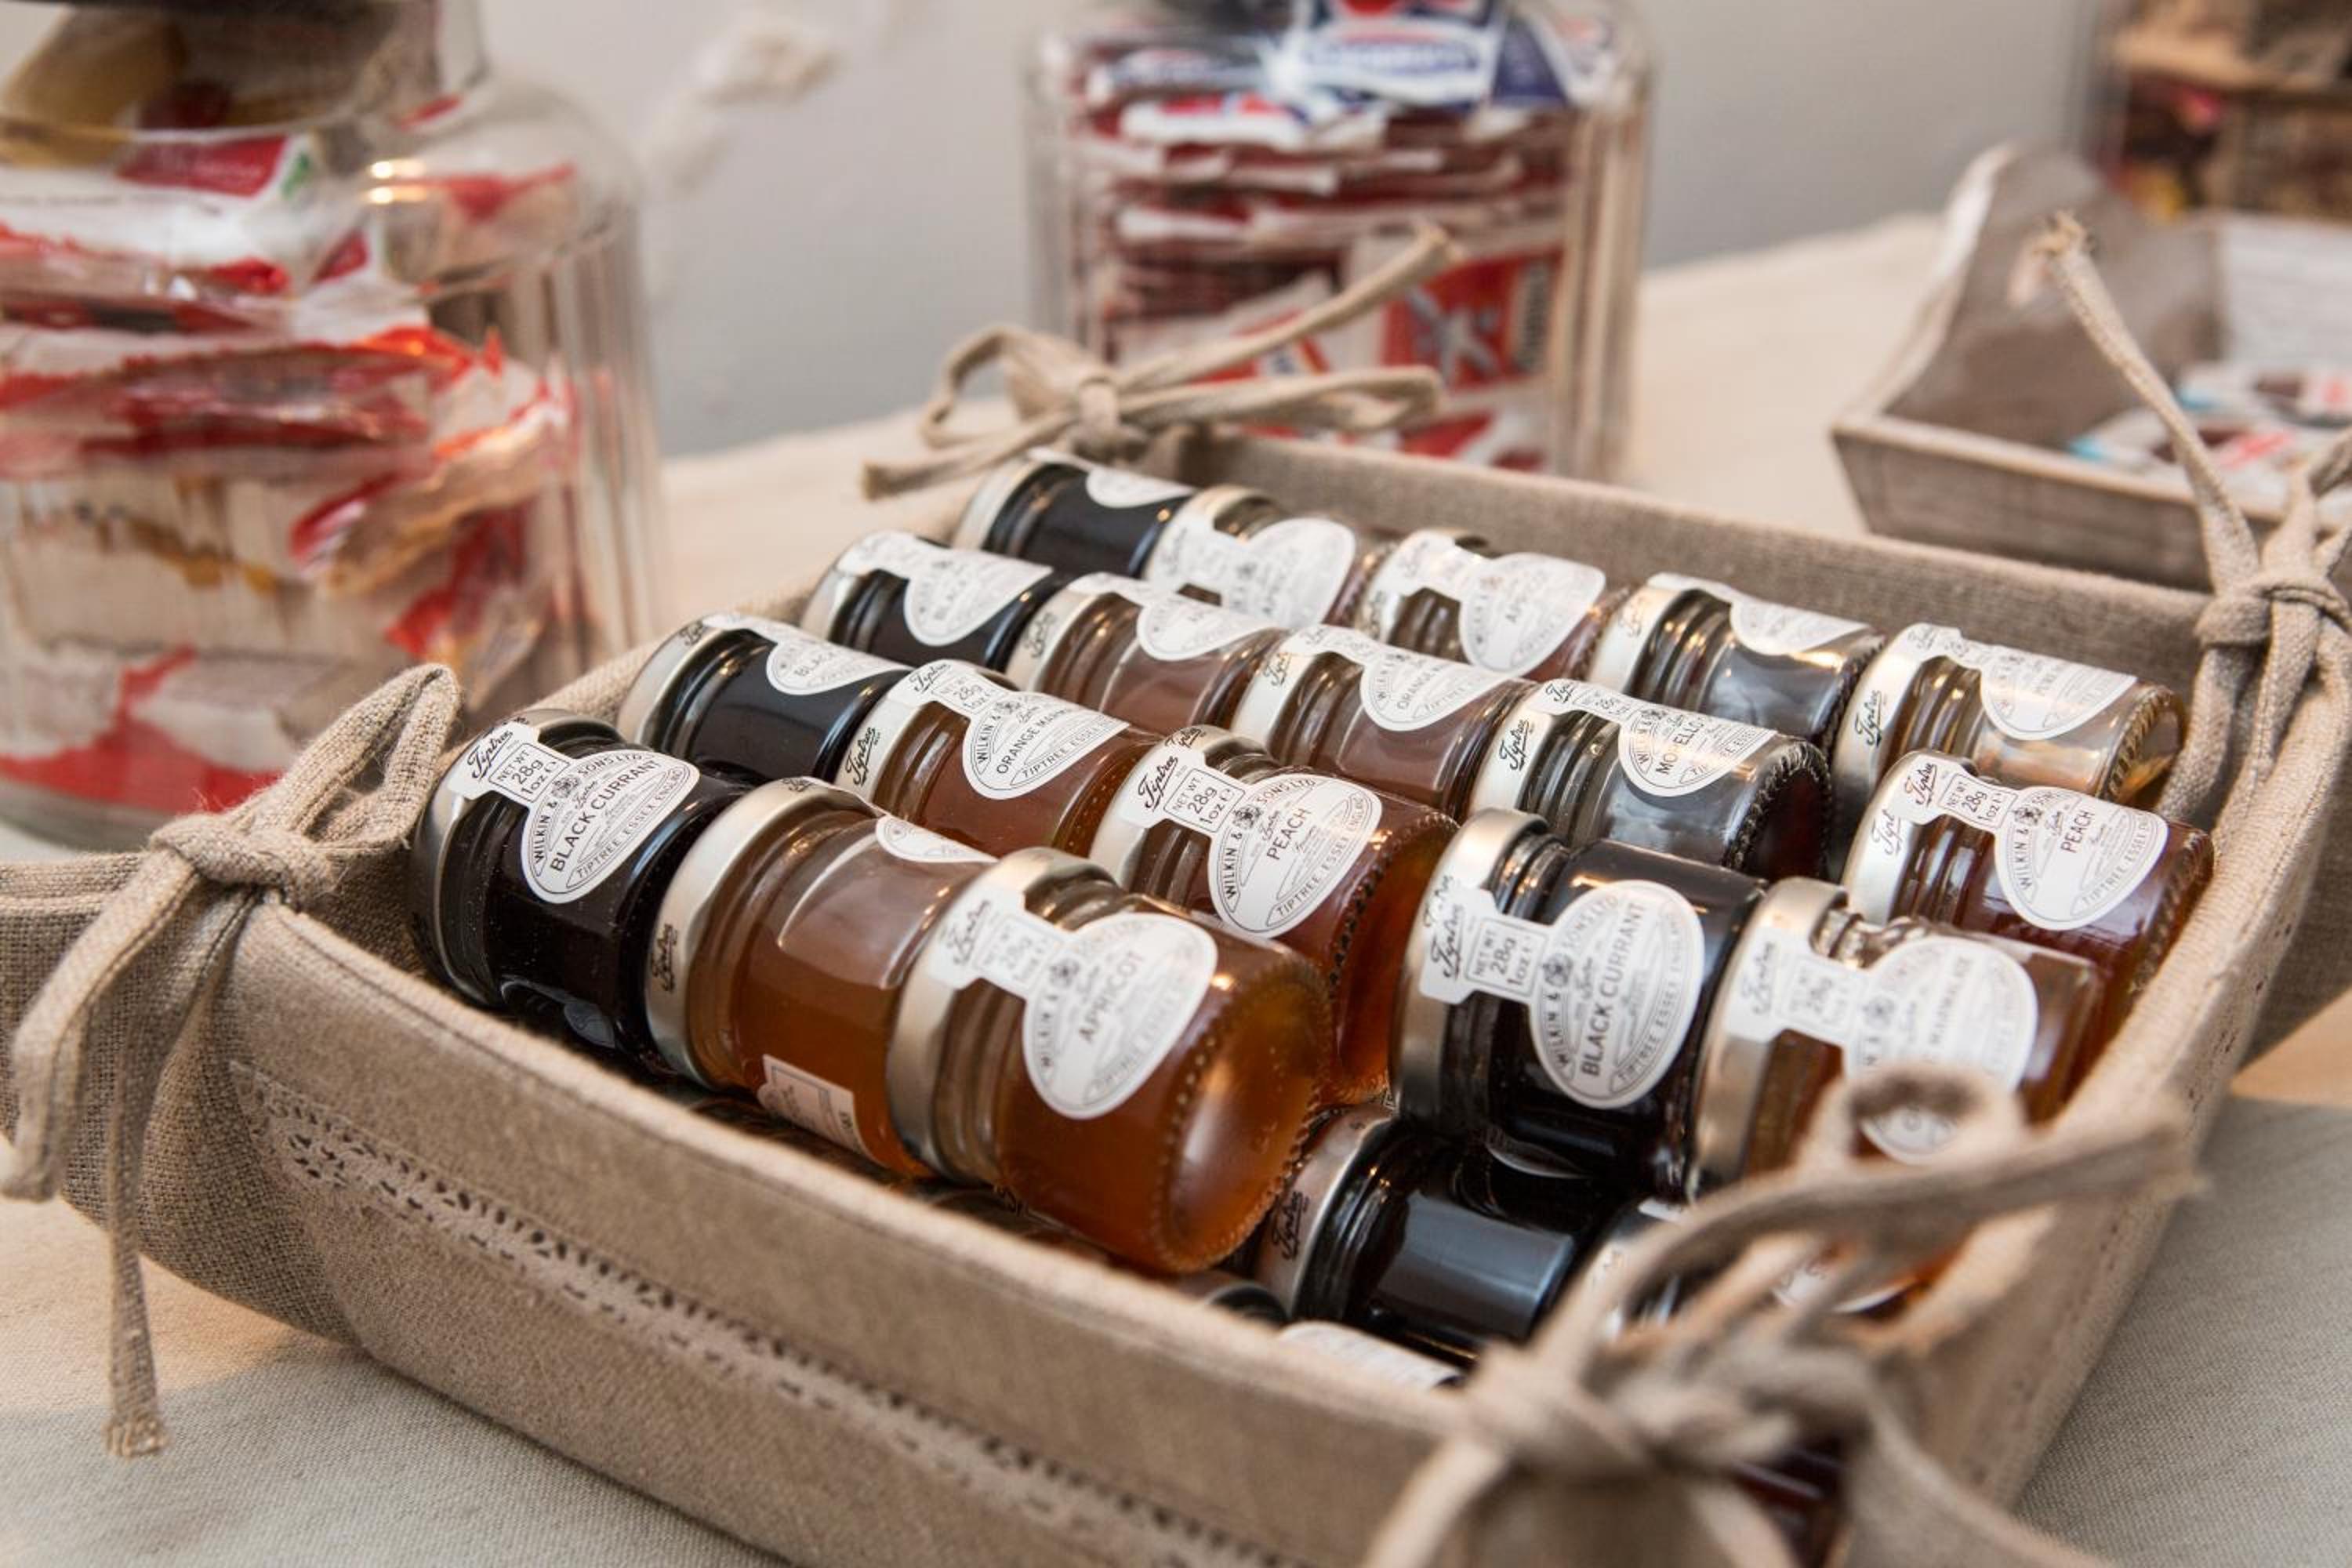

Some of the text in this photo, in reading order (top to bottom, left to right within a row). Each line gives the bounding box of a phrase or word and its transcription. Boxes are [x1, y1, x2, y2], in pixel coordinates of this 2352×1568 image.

[467, 731, 514, 781] Tiptree
[844, 727, 877, 788] Tiptree
[976, 723, 994, 764] WILKIN
[996, 725, 1040, 775] ORANGE
[1022, 745, 1069, 779] TIPTREE
[1499, 717, 1530, 771] Tiptree
[496, 763, 516, 782] NET
[511, 760, 543, 784] 28g
[1138, 756, 1178, 812] Tiptree
[532, 814, 551, 864] WILKIN
[577, 757, 615, 776] SONS
[549, 759, 662, 872] BLACK CURRANT
[1173, 786, 1190, 811] NET
[1188, 787, 1218, 814] 28g
[1200, 800, 1225, 825] 1oz
[1962, 790, 1987, 813] 28g
[1222, 848, 1238, 900] WILKIN
[1256, 784, 1290, 804] SONS
[1266, 808, 1312, 861] PEACH
[2060, 809, 2096, 853] PEACH
[575, 835, 621, 879] TIPTREE
[2015, 841, 2033, 889] WILKIN
[1276, 875, 1321, 916] TIPTREE
[2082, 864, 2126, 904] TIPTREE
[1475, 949, 1488, 976] NET
[1490, 938, 1517, 976] 28g
[1581, 902, 1645, 1077] BLACK CURRANT
[1548, 1011, 1570, 1067] WILKIN
